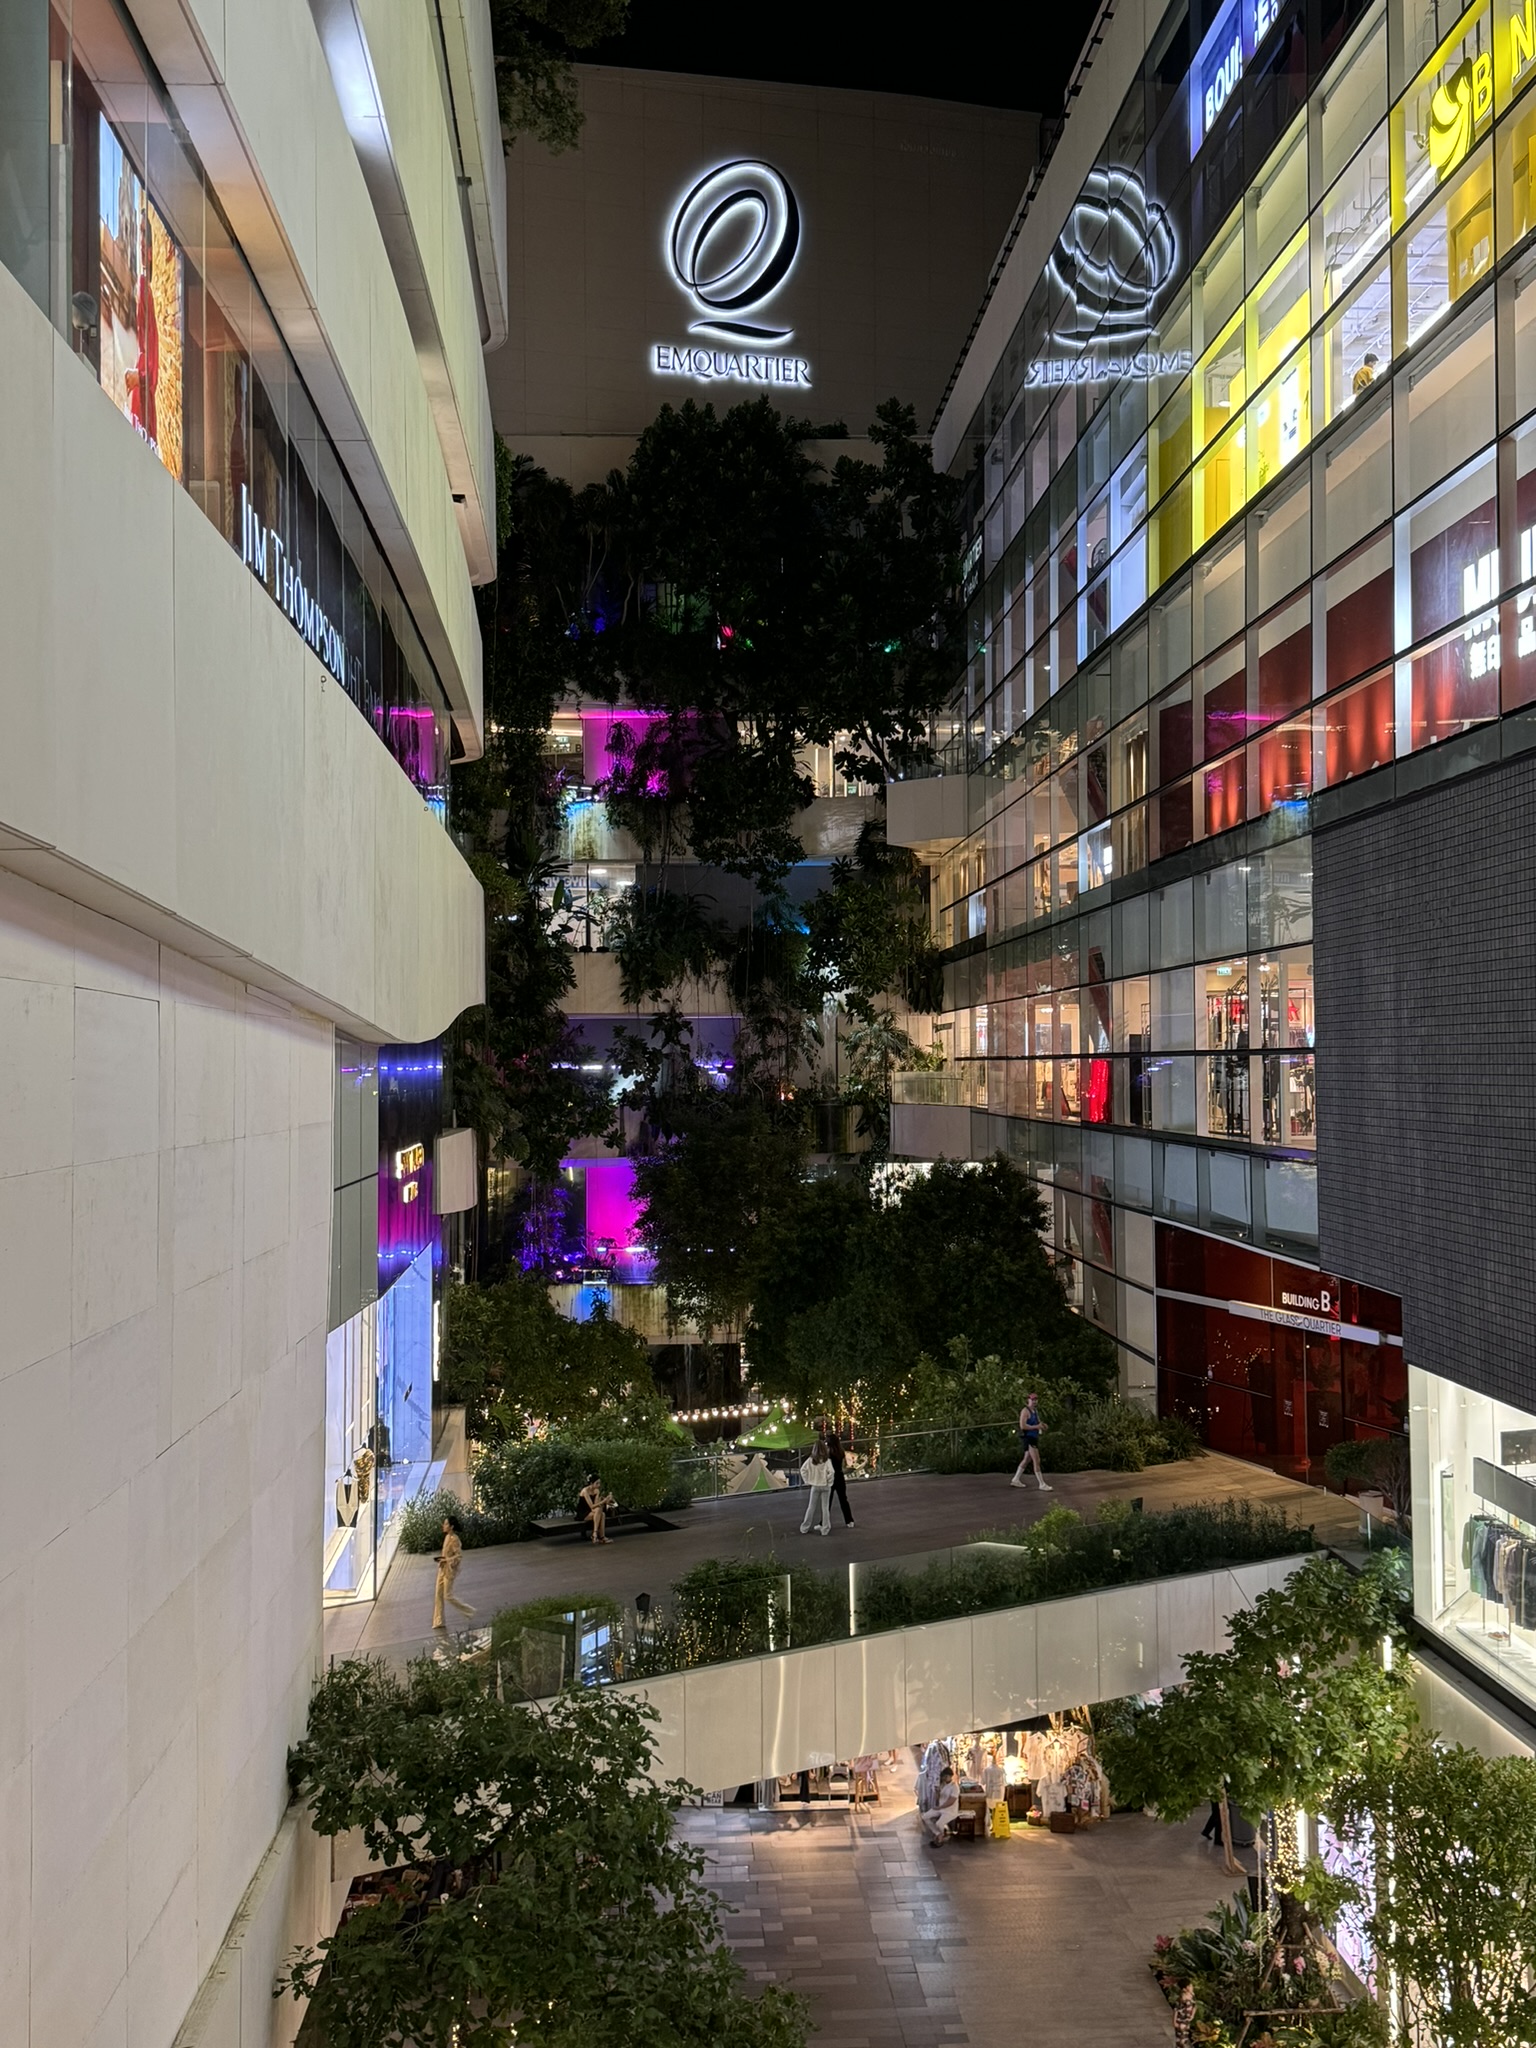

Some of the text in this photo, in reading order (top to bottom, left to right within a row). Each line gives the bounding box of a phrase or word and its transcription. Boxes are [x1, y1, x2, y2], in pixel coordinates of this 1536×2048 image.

[655, 345, 813, 385] EMQUARTIER
[241, 482, 345, 686] JIM THOMPSON
[1282, 1290, 1331, 1312] BUILDING B
[1260, 1309, 1342, 1336] THE GLASS QUARTIER
